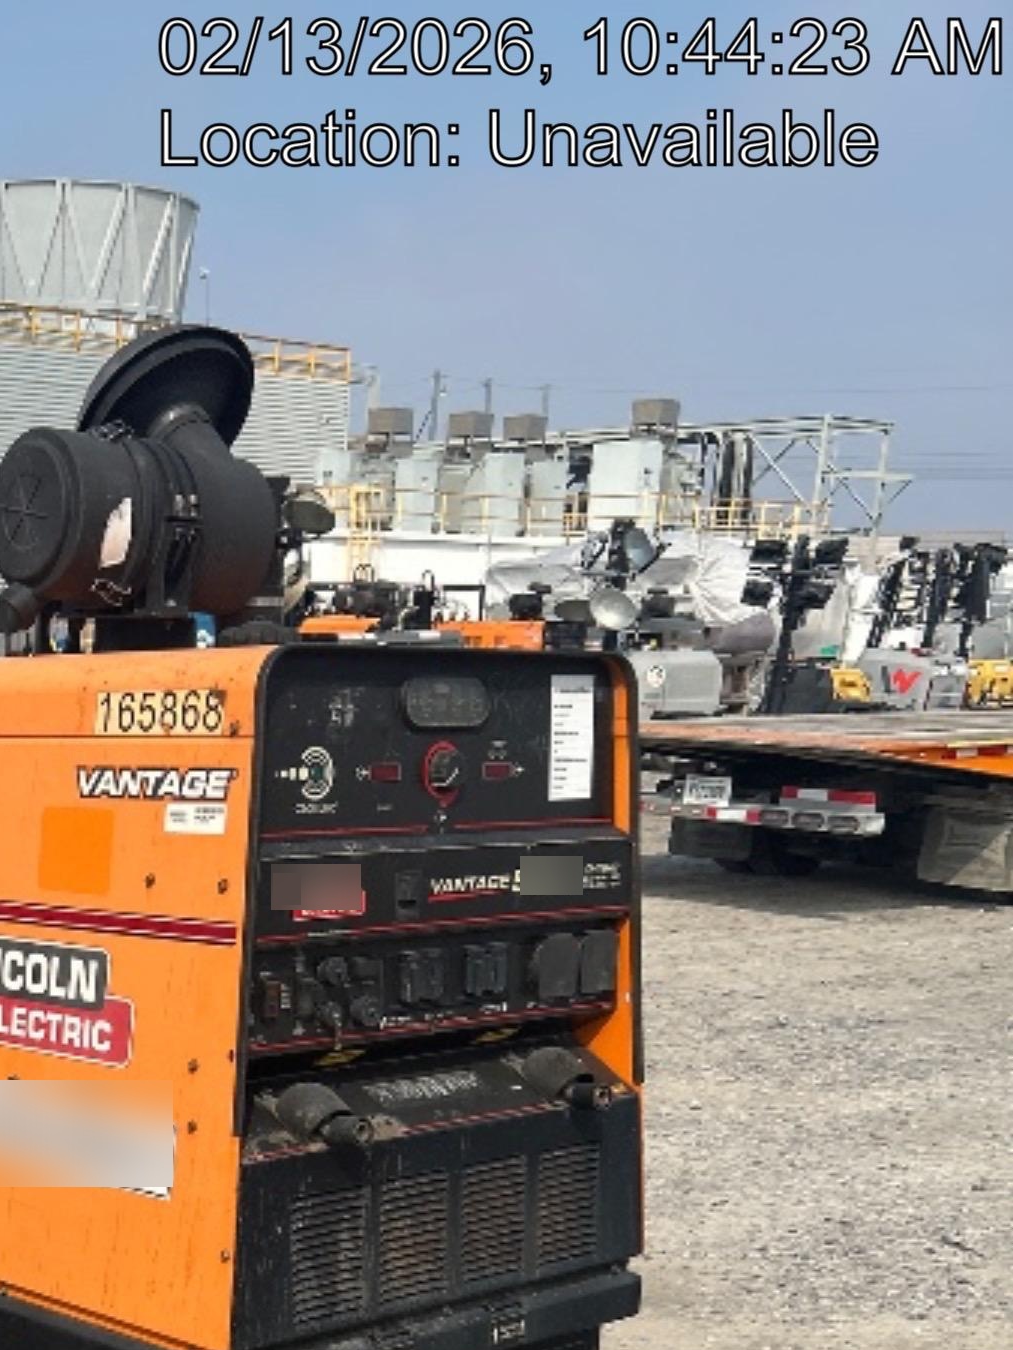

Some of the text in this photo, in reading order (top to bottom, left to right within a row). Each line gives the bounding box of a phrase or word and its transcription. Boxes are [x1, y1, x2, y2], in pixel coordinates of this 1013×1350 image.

[100, 690, 223, 733] 165868
[77, 766, 231, 800] VANTAGE
[431, 874, 512, 894] VANTAGE
